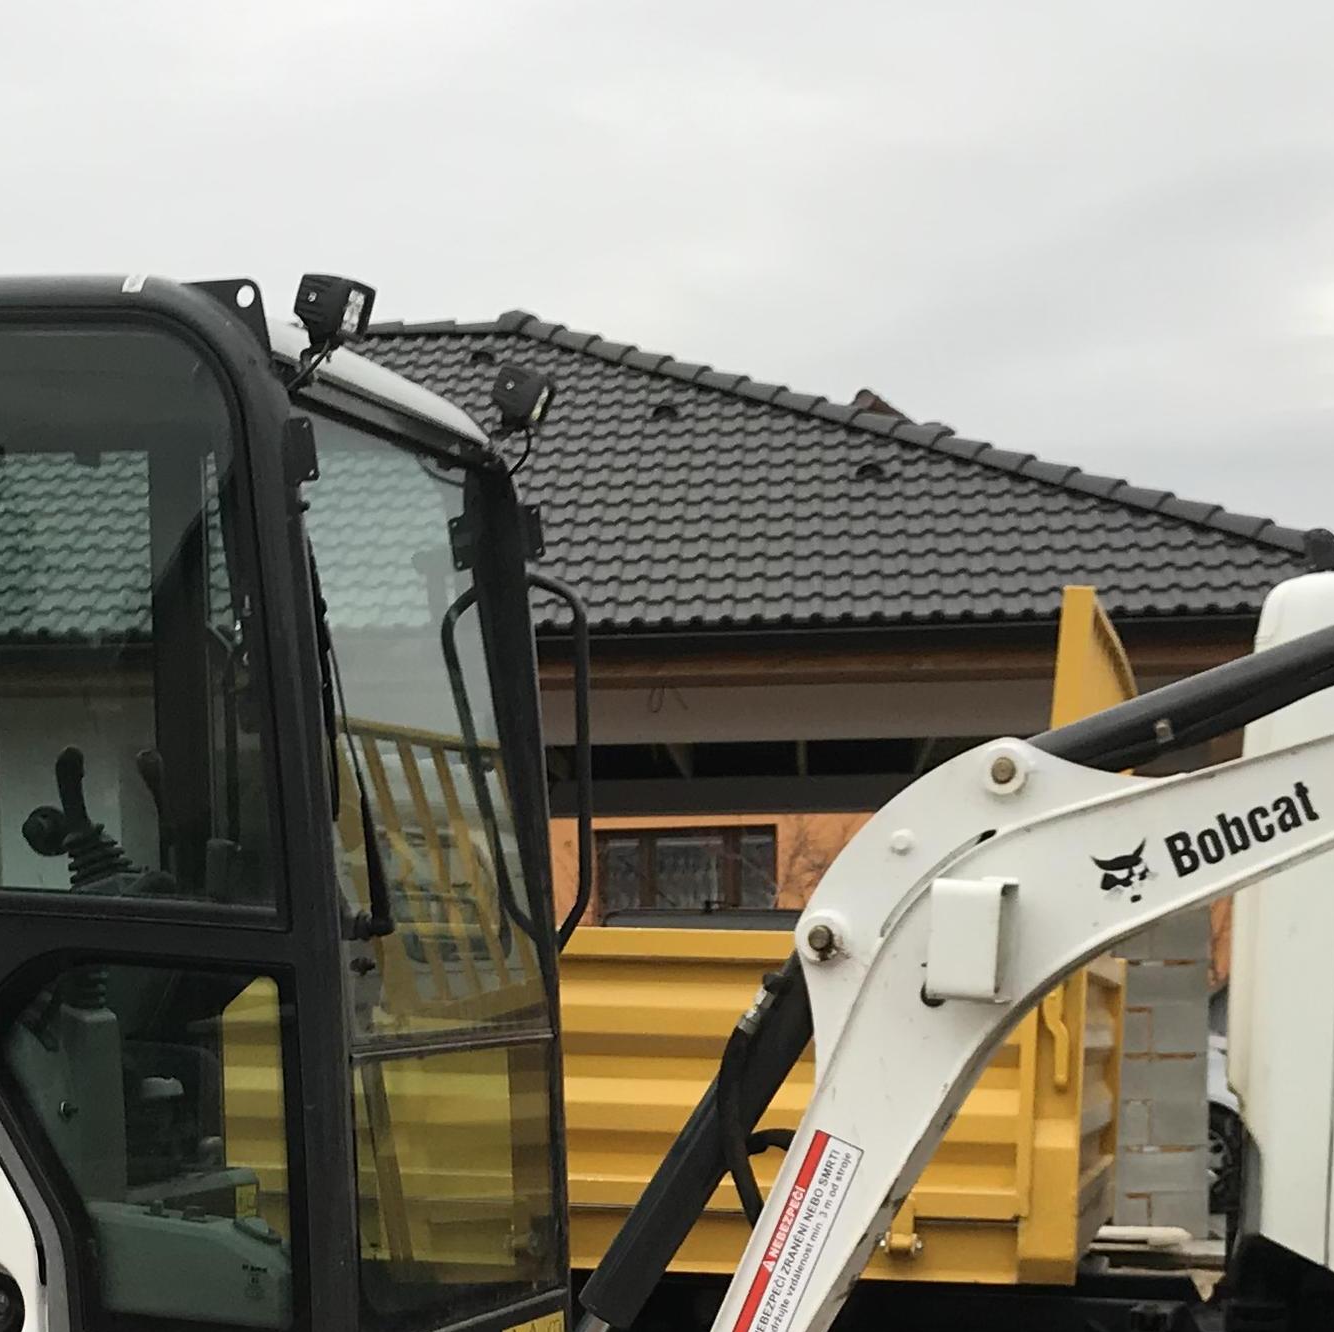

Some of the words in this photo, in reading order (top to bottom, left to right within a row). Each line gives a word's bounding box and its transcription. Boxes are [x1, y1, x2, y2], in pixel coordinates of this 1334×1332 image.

[1164, 781, 1320, 878] Bobcat
[805, 1187, 824, 1222] NEBO
[818, 1149, 841, 1186] SMRTI
[824, 1199, 832, 1209] m
[828, 1183, 839, 1197] od
[835, 1152, 852, 1183] stroje
[771, 1184, 806, 1259] NEBEZPEČÍ
